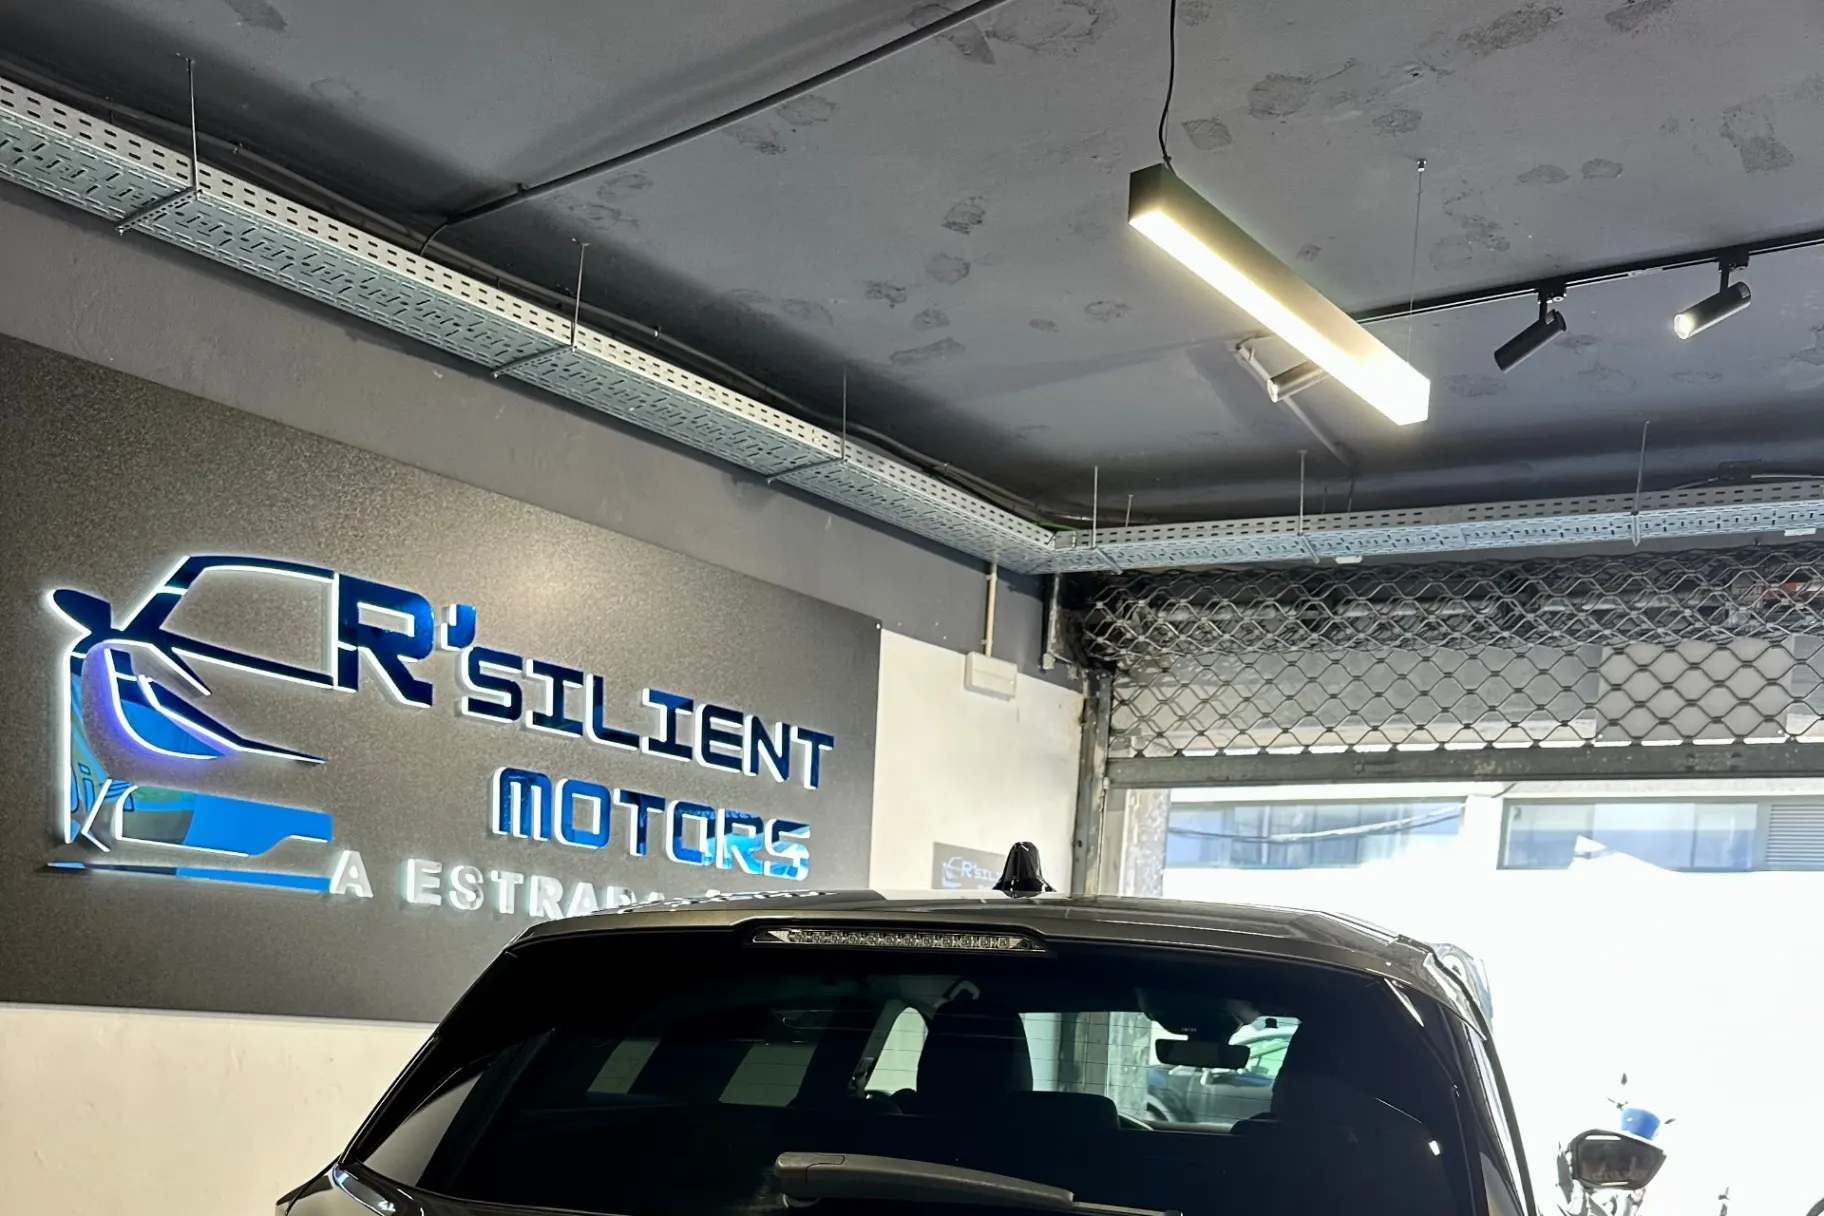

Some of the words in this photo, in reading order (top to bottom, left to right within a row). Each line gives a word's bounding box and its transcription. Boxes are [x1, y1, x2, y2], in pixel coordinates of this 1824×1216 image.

[336, 573, 835, 790] R'SILIENT
[491, 766, 811, 882] MOTORS
[329, 850, 375, 898] A
[406, 857, 667, 920] ESTRAD
